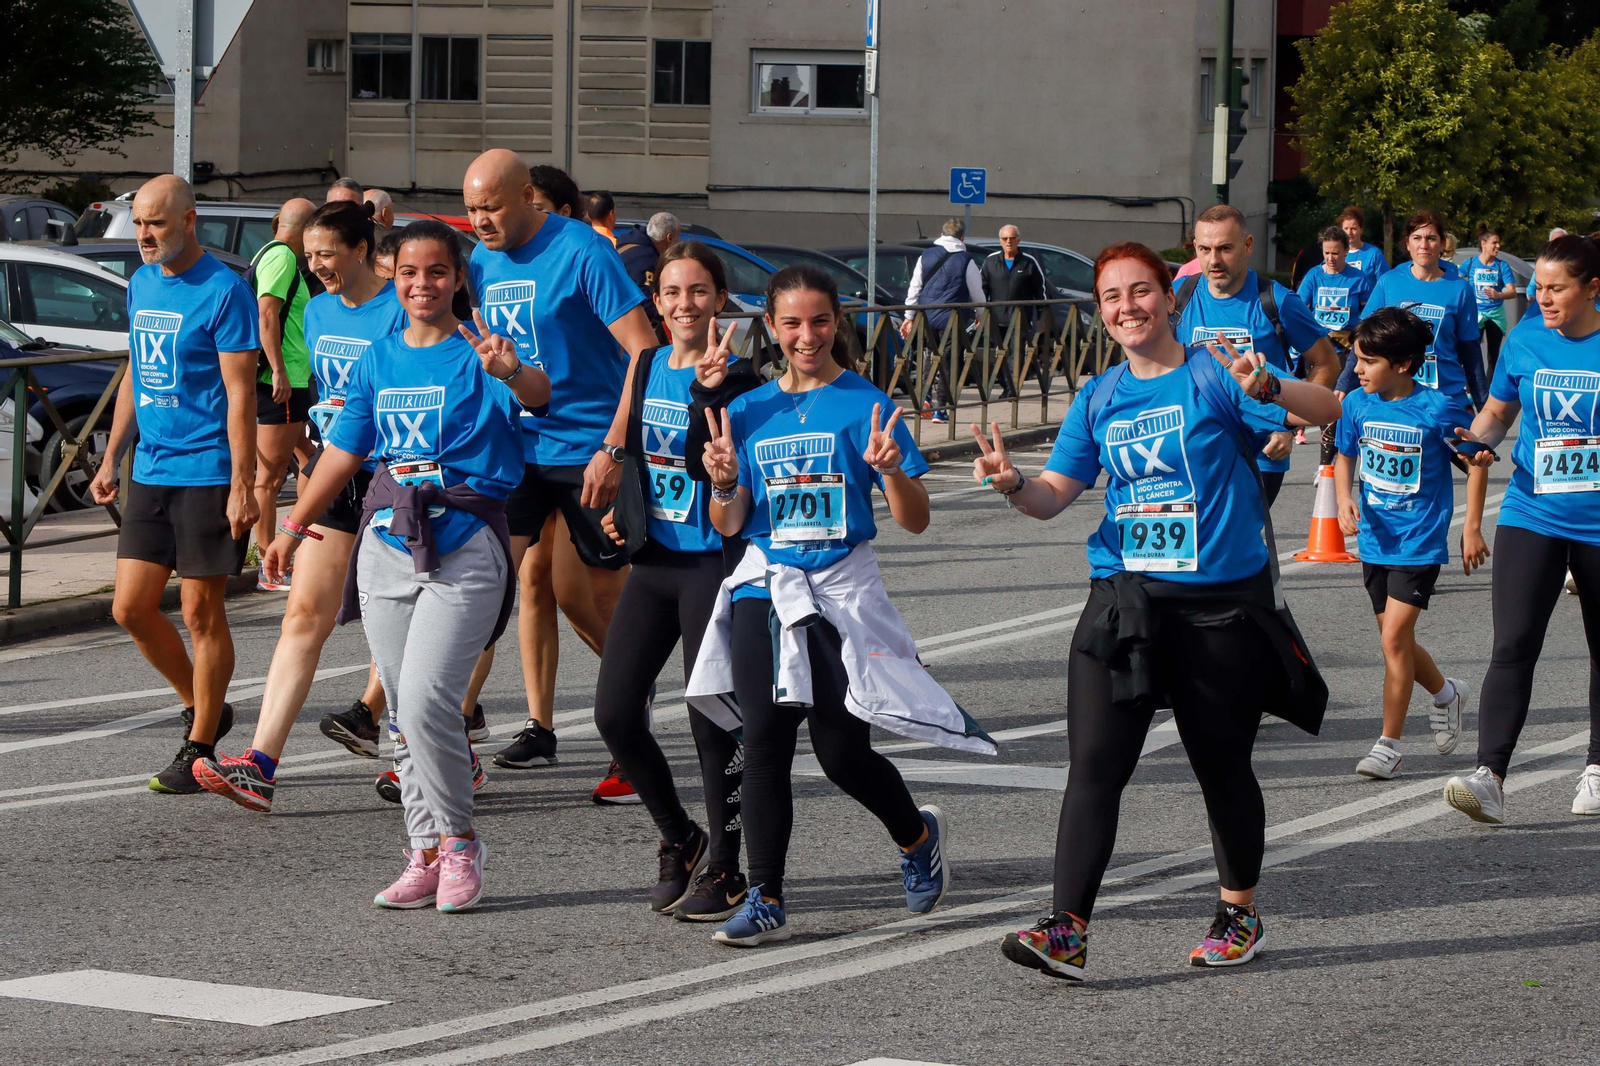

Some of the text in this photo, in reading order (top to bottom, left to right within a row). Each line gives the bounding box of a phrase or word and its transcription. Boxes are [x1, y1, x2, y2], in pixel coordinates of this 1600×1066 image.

[1477, 273, 1496, 281] 3906
[490, 304, 527, 335] IX
[1319, 312, 1346, 324] 4256
[139, 332, 168, 365] IX
[321, 358, 354, 389] IX
[1417, 364, 1431, 379] 01
[1542, 391, 1583, 423] IX
[386, 412, 431, 449] IX
[642, 425, 679, 456] IX
[1118, 436, 1176, 479] IX
[1366, 449, 1414, 478] 3230
[1543, 452, 1600, 476] 2424
[654, 473, 685, 501] 59
[1136, 475, 1163, 486] EDICIÓN
[1136, 480, 1183, 493] VIGO CONTRA
[1145, 489, 1175, 499] CÁNCER
[775, 492, 831, 521] 2701
[1118, 521, 1186, 551] 1939
[724, 763, 744, 775] adid
